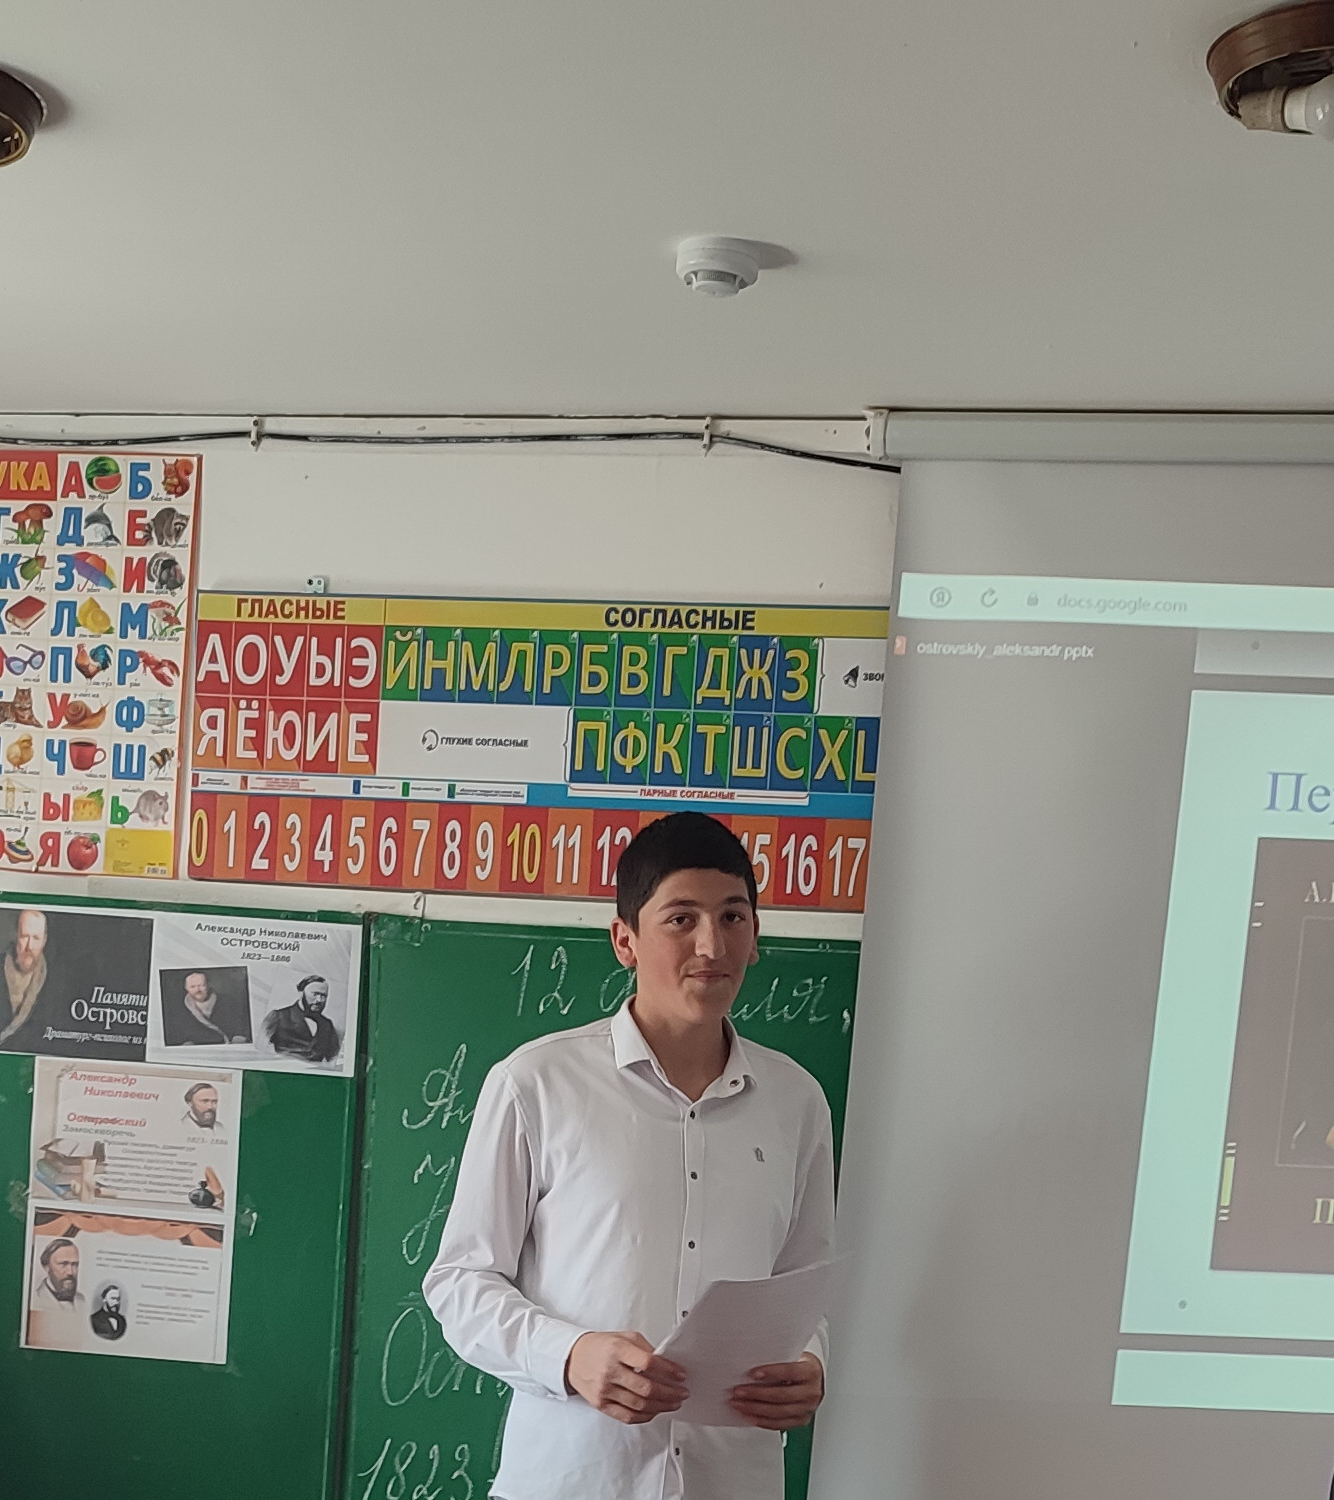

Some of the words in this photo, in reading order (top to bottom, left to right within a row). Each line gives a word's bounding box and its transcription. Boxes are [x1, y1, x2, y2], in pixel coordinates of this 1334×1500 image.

[60, 460, 86, 499] А
[128, 462, 152, 500] Б
[57, 507, 84, 547] Д
[127, 509, 147, 547] Е
[54, 555, 75, 591] З
[122, 556, 146, 594] И
[50, 600, 77, 637] Л
[119, 602, 149, 639] М
[235, 597, 346, 621] ГЛАСНЫЕ
[604, 606, 756, 631] СОГЛАСНЫЕ
[1056, 593, 1188, 615] docs.google.com
[50, 646, 73, 683] П
[118, 648, 139, 686] Р
[46, 692, 72, 729] У
[115, 696, 145, 733] Ф
[45, 738, 67, 776] Ч
[111, 743, 146, 780] Ш
[440, 735, 473, 747] ГЛУХИЕ
[475, 737, 529, 749] СОГЛАСНЫЕ
[42, 791, 71, 822] Ы
[109, 795, 129, 825] Ь
[639, 787, 678, 798] ПАРНЫЕ
[680, 789, 736, 801] СОГЛАСНЫЕ
[37, 830, 61, 868] Я
[191, 808, 208, 867] 0
[223, 809, 236, 868] 1
[251, 811, 271, 870] 2
[283, 812, 302, 872] 3
[314, 813, 334, 873] 4
[346, 816, 366, 875] 5
[378, 816, 398, 877] 6
[412, 819, 431, 877] 7
[442, 819, 462, 880] 8
[475, 821, 495, 881] 9
[507, 822, 541, 884] 10
[551, 824, 582, 884] 11
[781, 833, 818, 896] 16
[828, 836, 867, 897] 17
[195, 922, 257, 937] Александр
[259, 928, 328, 941] Николаевич
[220, 937, 301, 952] ОСТРОВСКИЙ
[90, 986, 147, 1007] Памяти
[513, 944, 574, 1018] 12
[70, 998, 147, 1030] Островс
[69, 1071, 137, 1086] Александр
[83, 1086, 159, 1101] Николаевич
